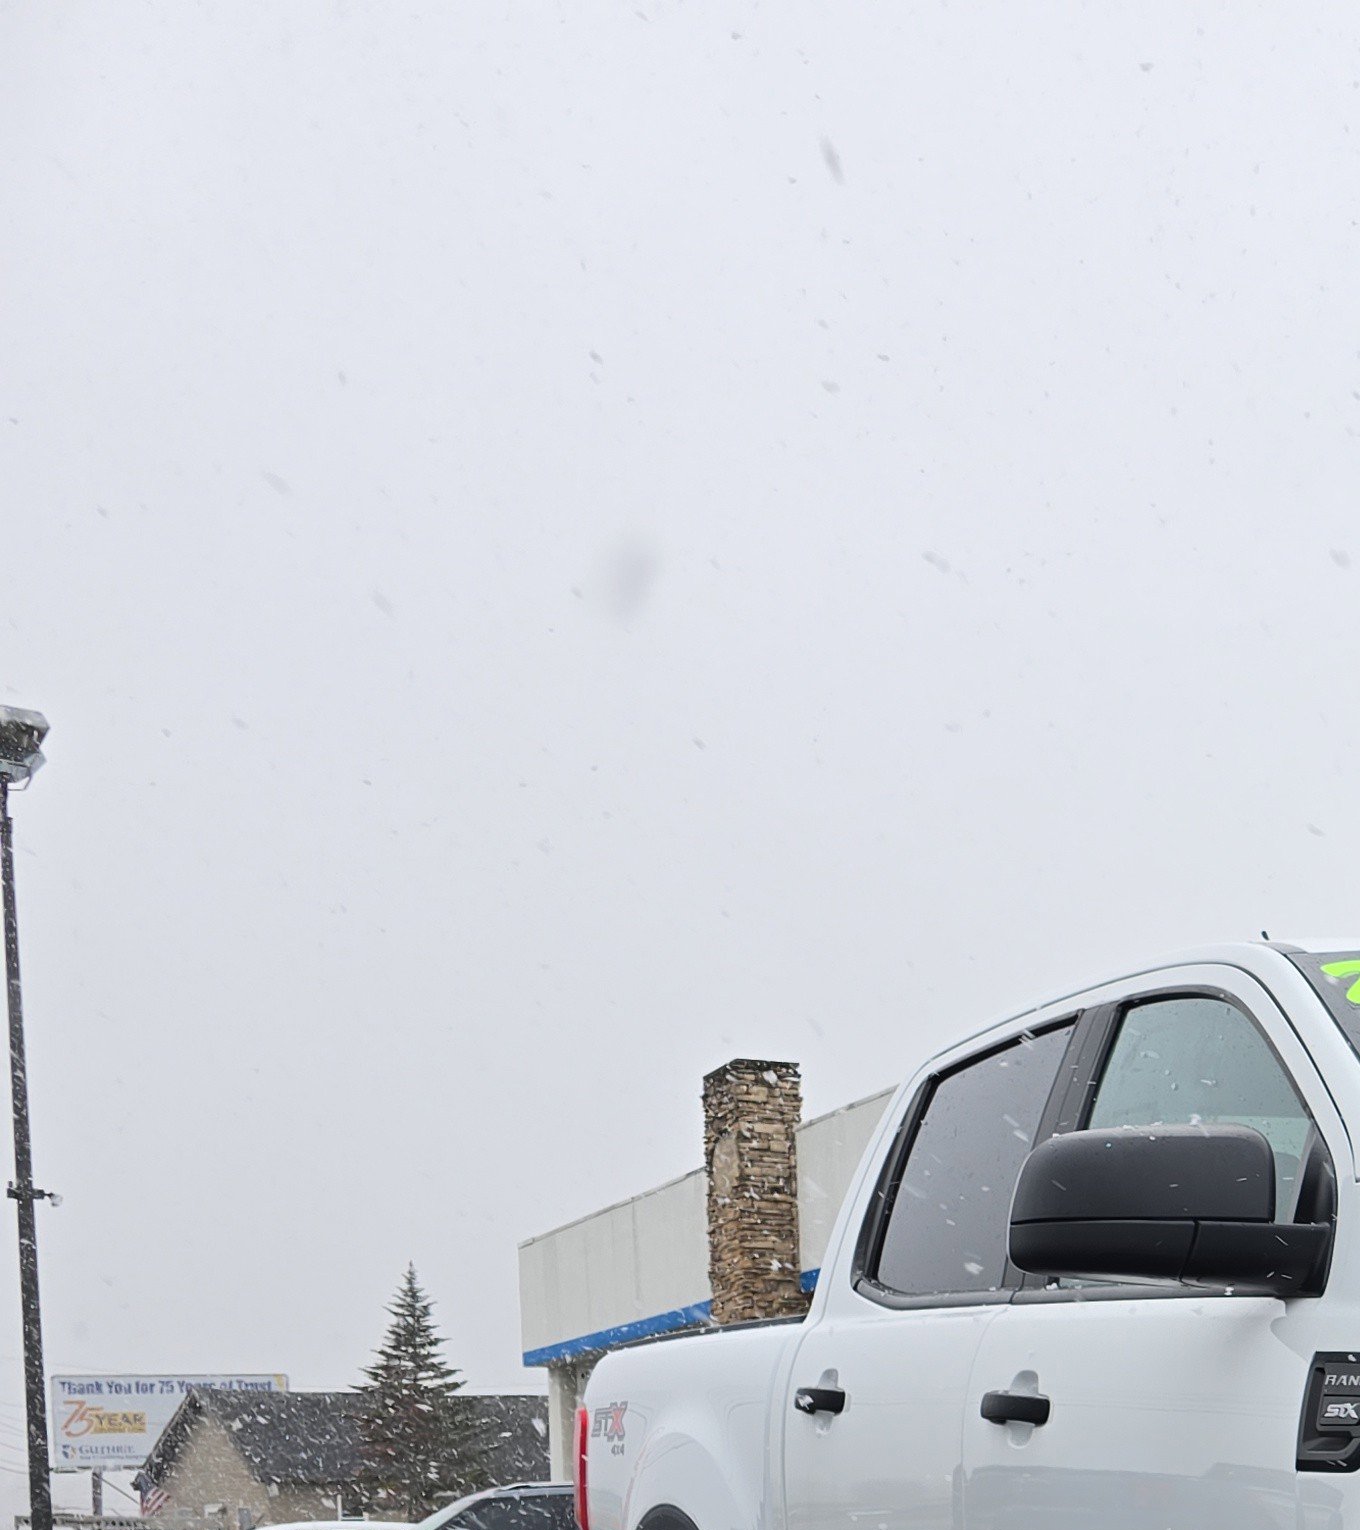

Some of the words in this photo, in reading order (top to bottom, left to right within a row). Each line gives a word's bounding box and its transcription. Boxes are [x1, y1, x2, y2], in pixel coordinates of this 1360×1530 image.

[60, 1381, 103, 1394] Thank
[107, 1381, 132, 1394] You
[135, 1380, 155, 1394] for
[159, 1381, 174, 1394] 75
[61, 1400, 103, 1437] 75
[95, 1412, 146, 1426] YEAR
[1324, 1402, 1360, 1419] STX
[591, 1401, 628, 1442] STX
